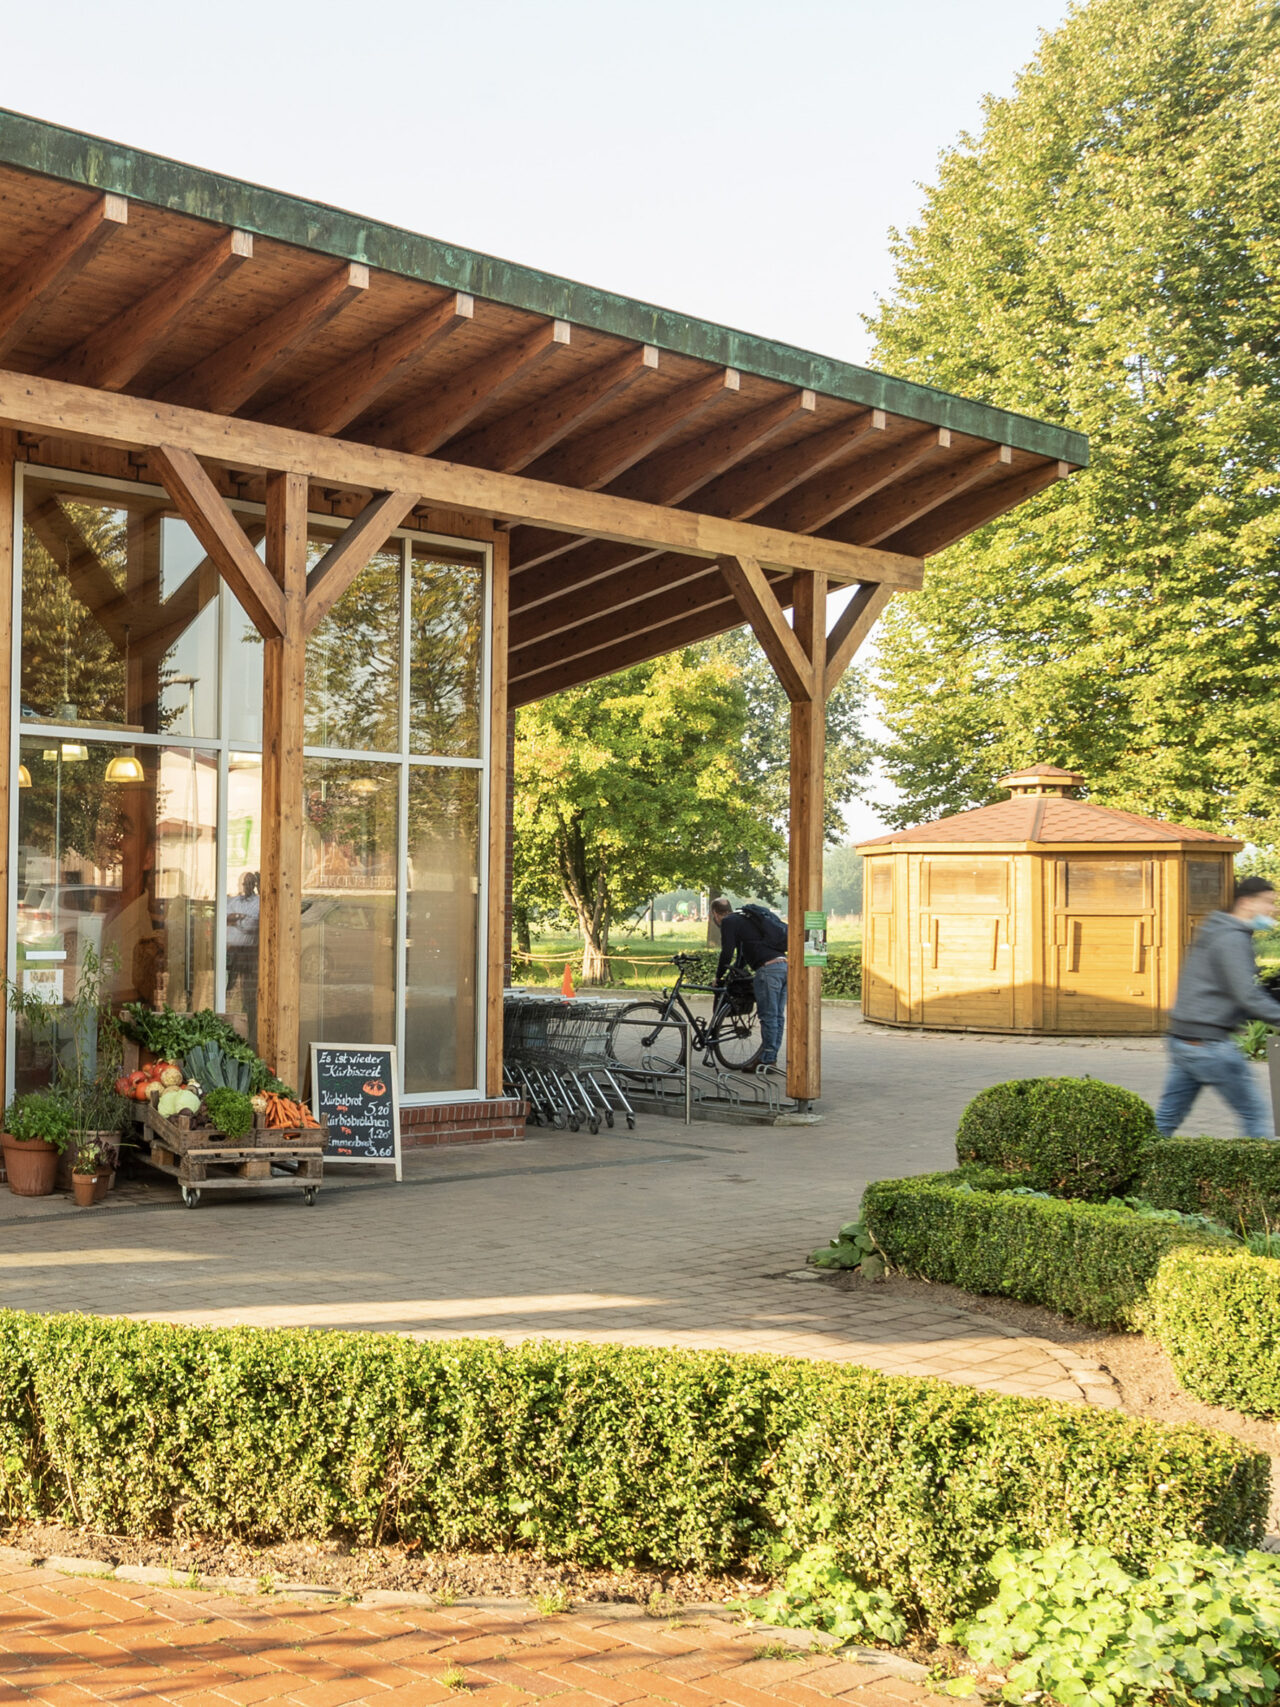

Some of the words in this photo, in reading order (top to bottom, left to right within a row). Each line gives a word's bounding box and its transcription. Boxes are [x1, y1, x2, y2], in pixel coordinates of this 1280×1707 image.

[319, 1051, 332, 1064] Es
[334, 1052, 348, 1064] ist
[349, 1053, 384, 1064] wieder
[322, 1064, 382, 1077] Kürbiszeit
[320, 1090, 363, 1106] Kürbisbrot
